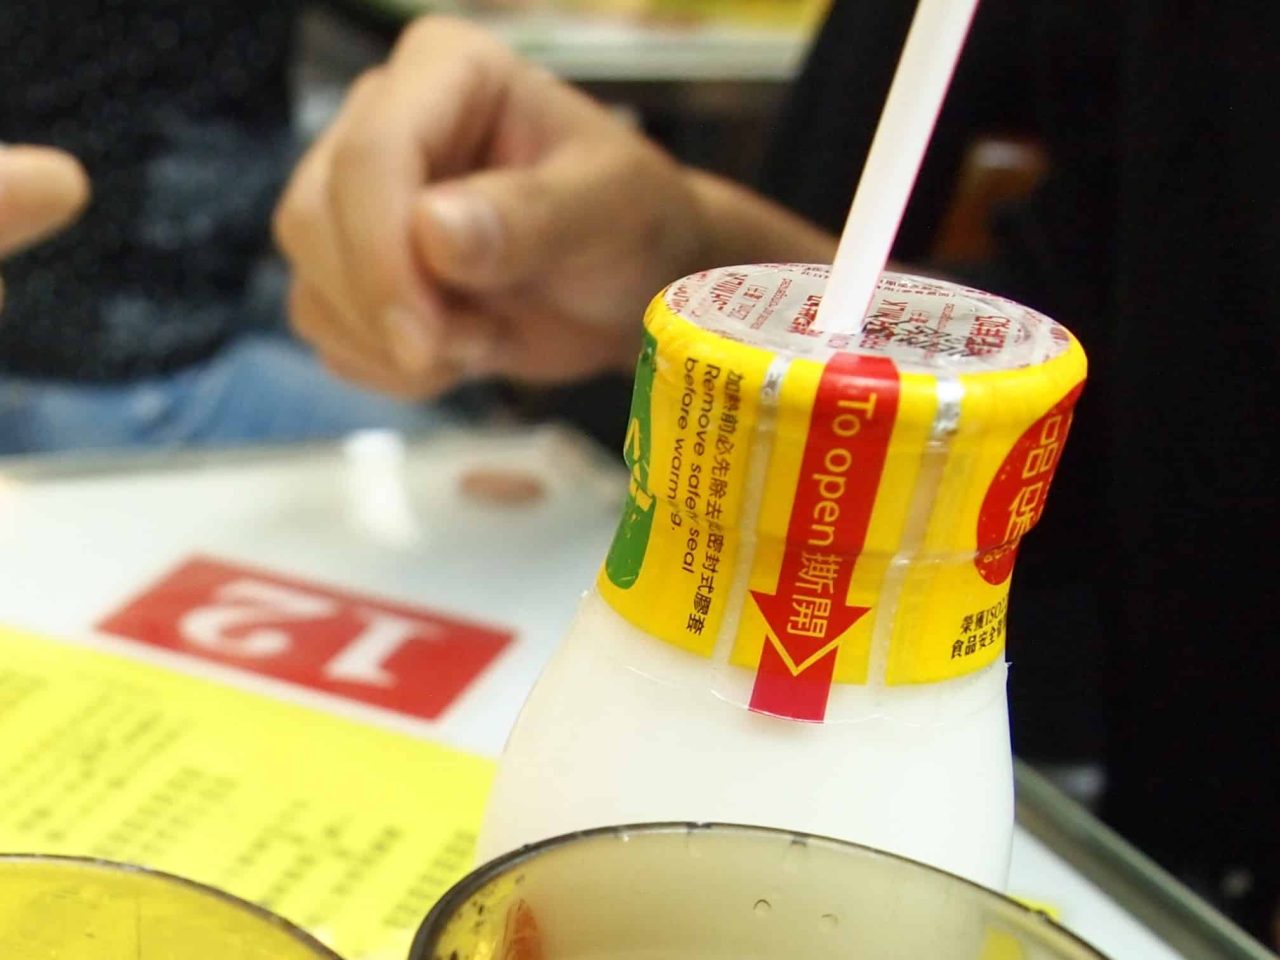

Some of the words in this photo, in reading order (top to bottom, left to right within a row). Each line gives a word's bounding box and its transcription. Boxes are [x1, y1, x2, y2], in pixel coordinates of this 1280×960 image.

[677, 356, 699, 431] before
[693, 363, 721, 456] Remove
[831, 393, 878, 438] To
[666, 437, 686, 531] warmg.
[811, 449, 853, 547] open
[682, 528, 700, 574] seal
[786, 548, 837, 638] 撕開
[178, 577, 446, 688] 12
